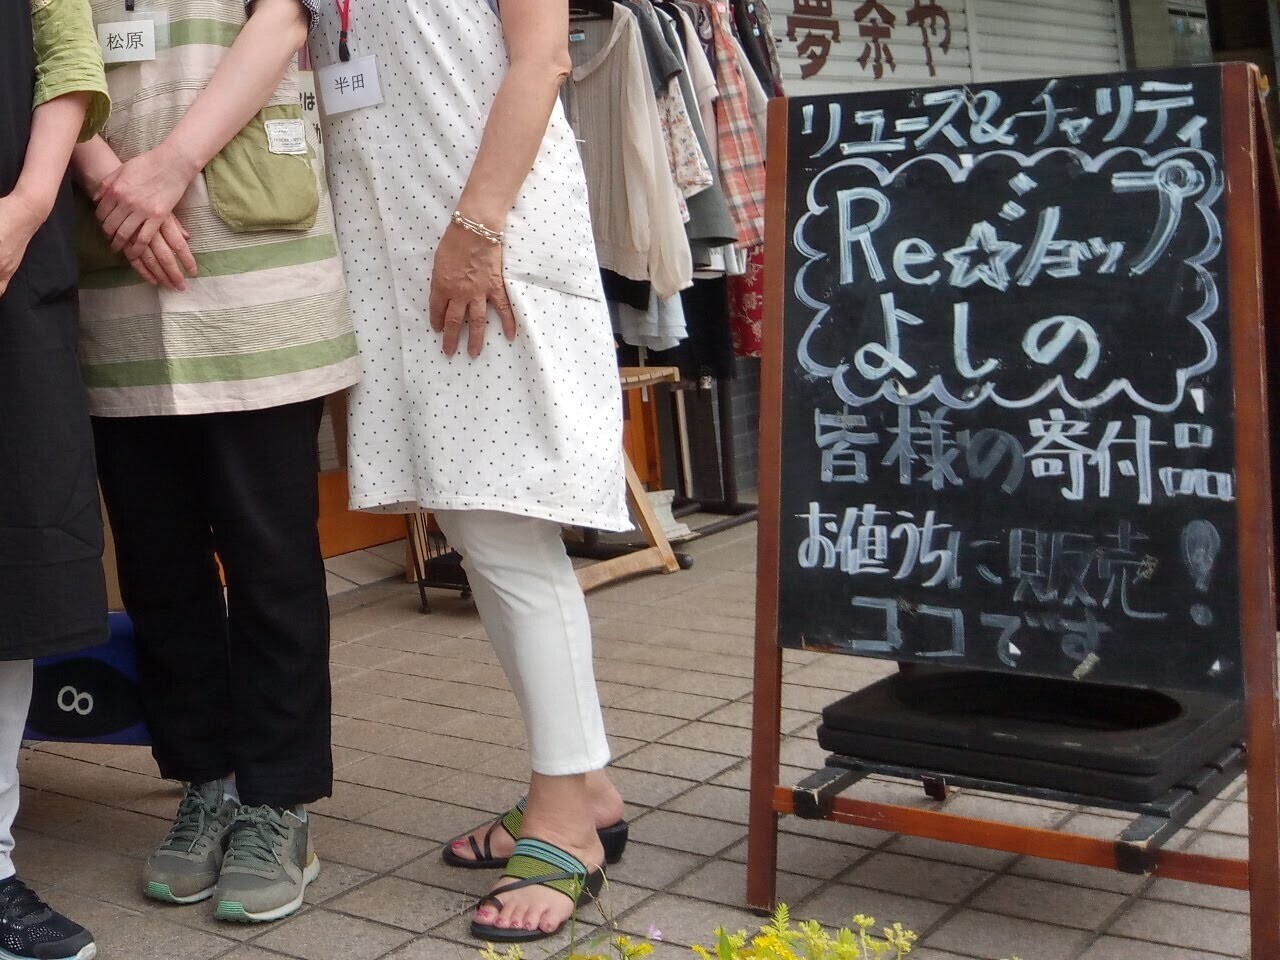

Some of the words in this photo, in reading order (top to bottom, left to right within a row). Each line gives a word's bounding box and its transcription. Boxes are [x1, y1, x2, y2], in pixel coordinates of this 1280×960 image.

[106, 30, 144, 51] 松原
[334, 73, 366, 96] 半田
[853, 291, 1101, 380] よしの
[814, 406, 1236, 505] 皆様の寄付品
[850, 595, 1112, 668] ココです
